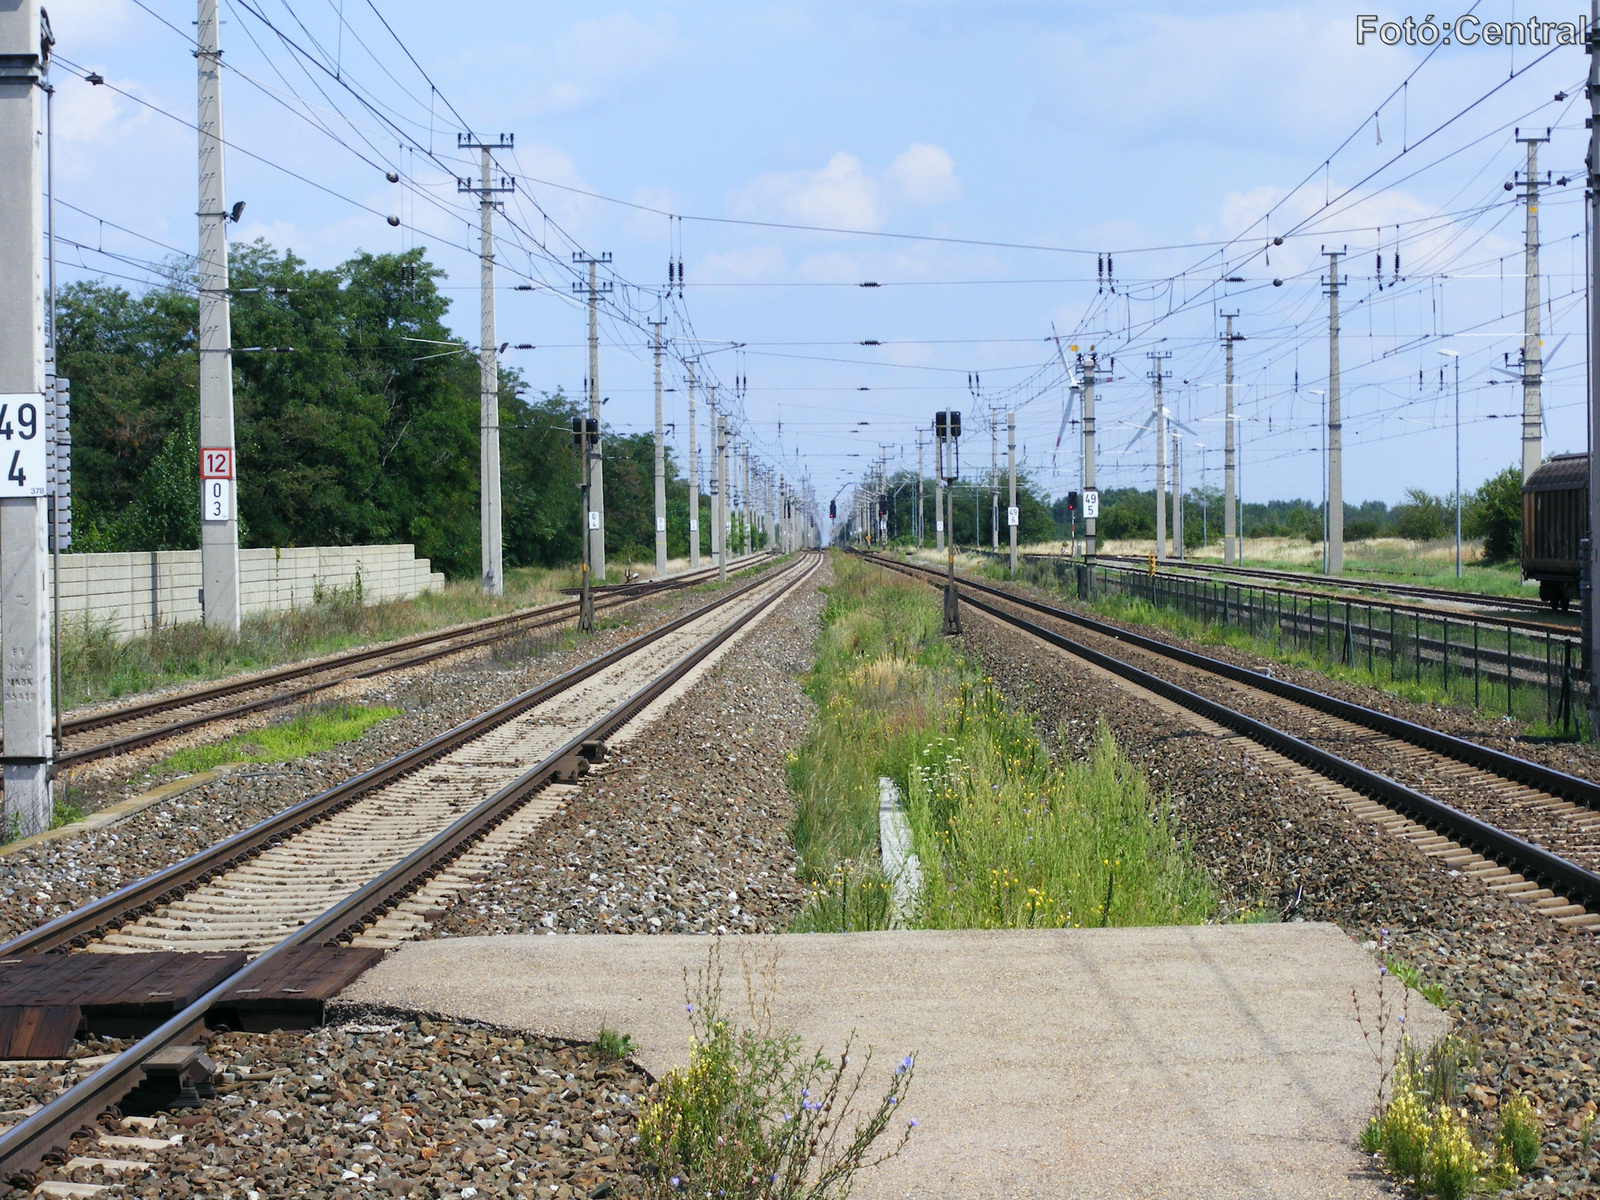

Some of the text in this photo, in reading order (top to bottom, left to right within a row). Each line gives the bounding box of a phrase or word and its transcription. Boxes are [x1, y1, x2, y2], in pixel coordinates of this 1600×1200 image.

[0, 403, 36, 440] 49
[8, 450, 26, 486] 4
[207, 453, 226, 473] 12
[30, 487, 45, 495] 378
[213, 482, 221, 498] 0
[1085, 493, 1096, 504] 49
[213, 501, 221, 516] 3
[1088, 505, 1093, 515] 5
